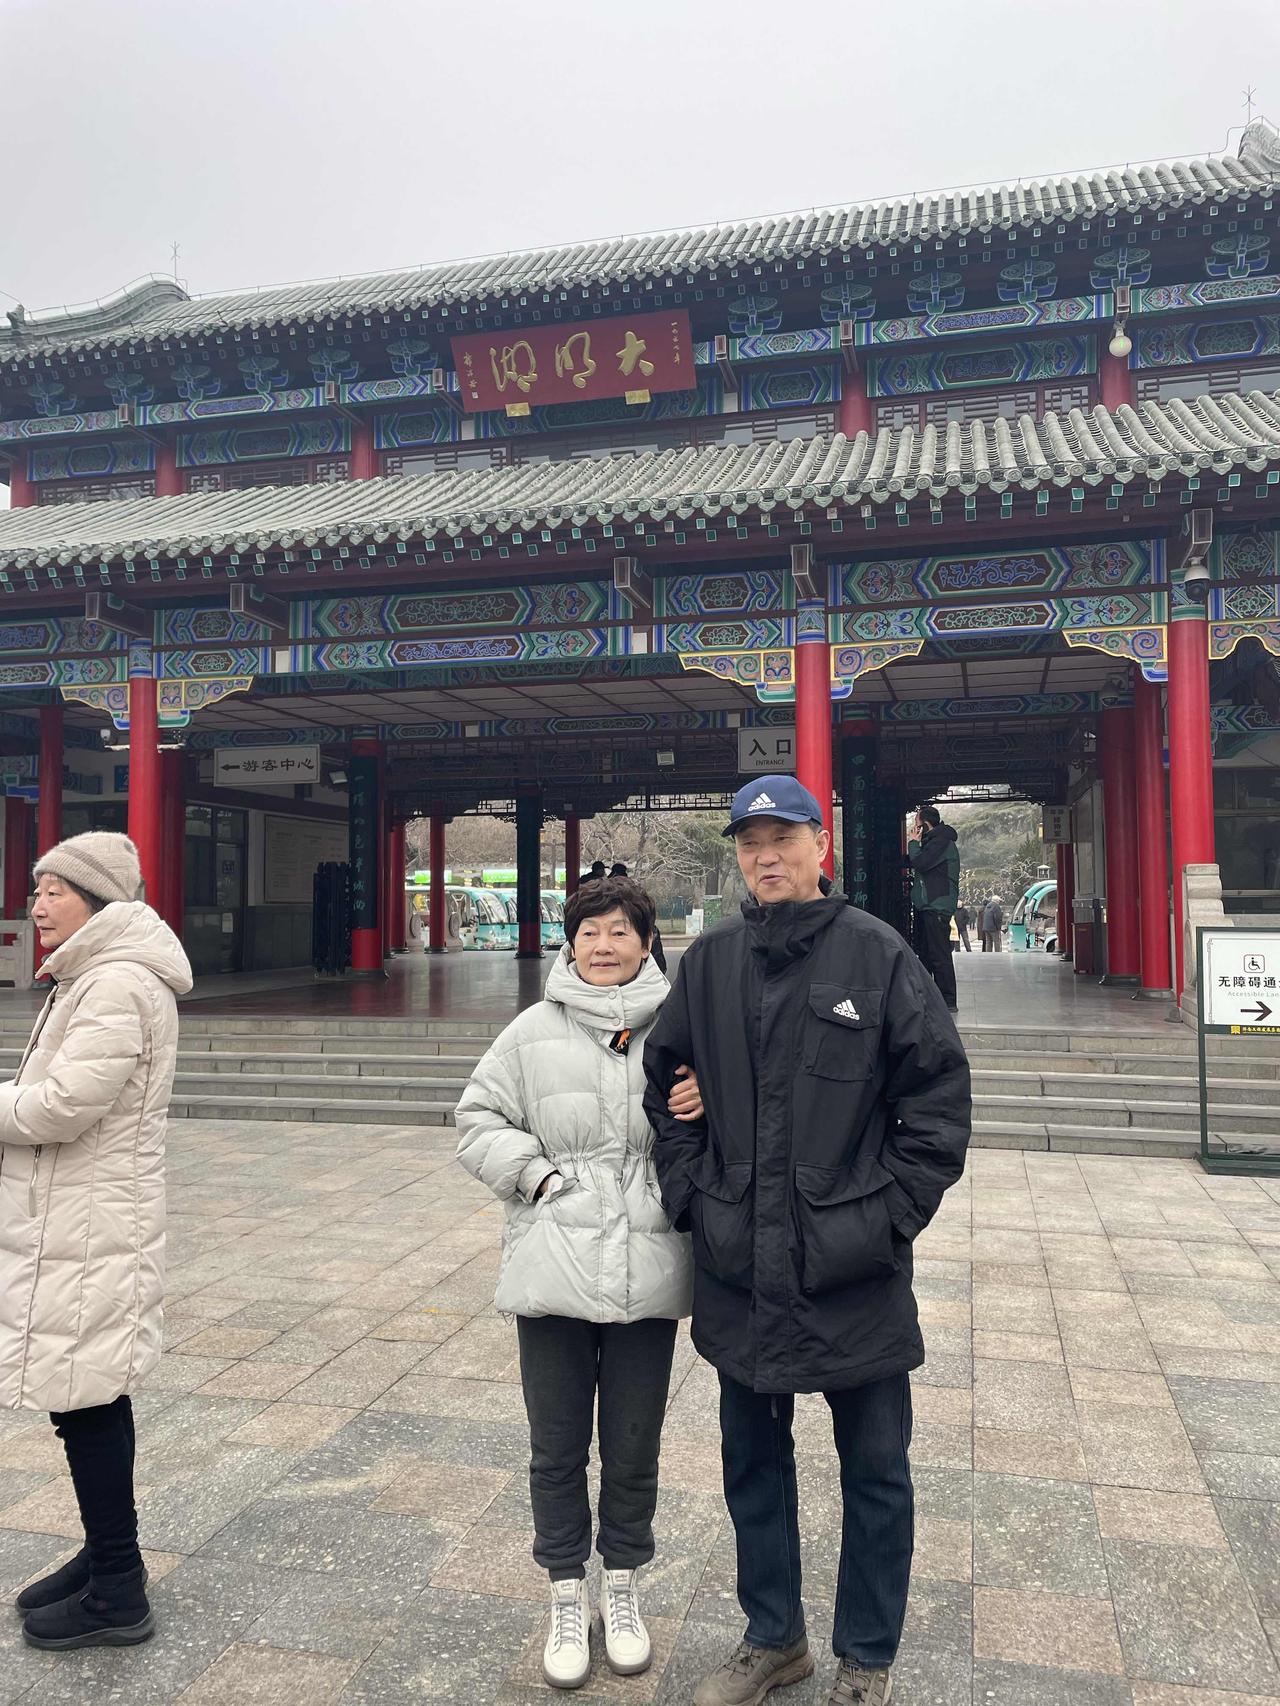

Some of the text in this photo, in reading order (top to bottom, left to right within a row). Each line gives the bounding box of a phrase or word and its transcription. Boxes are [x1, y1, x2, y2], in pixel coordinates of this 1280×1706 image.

[748, 738, 791, 756] 入口
[242, 758, 315, 772] 游客中心
[755, 759, 785, 767] ENTRANCE
[851, 754, 868, 910] 四面荷花三面柳
[1218, 976, 1280, 988] 无障碍通
